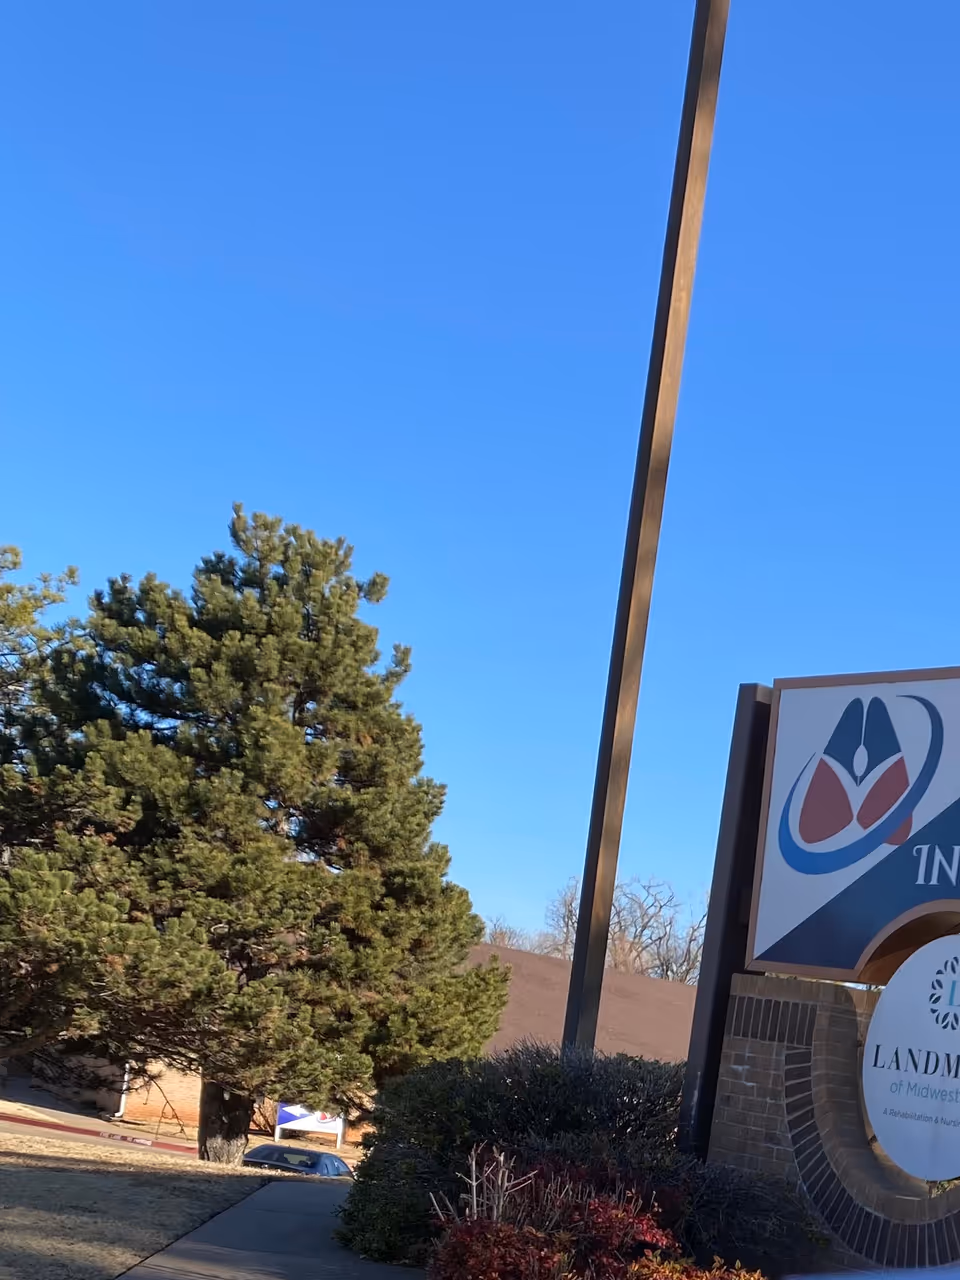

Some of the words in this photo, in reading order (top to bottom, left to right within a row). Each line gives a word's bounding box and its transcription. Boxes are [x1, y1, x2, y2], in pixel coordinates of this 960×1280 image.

[890, 1080, 904, 1096] of
[906, 1081, 960, 1104] Midwest
[889, 1108, 933, 1124] Rehabilitation
